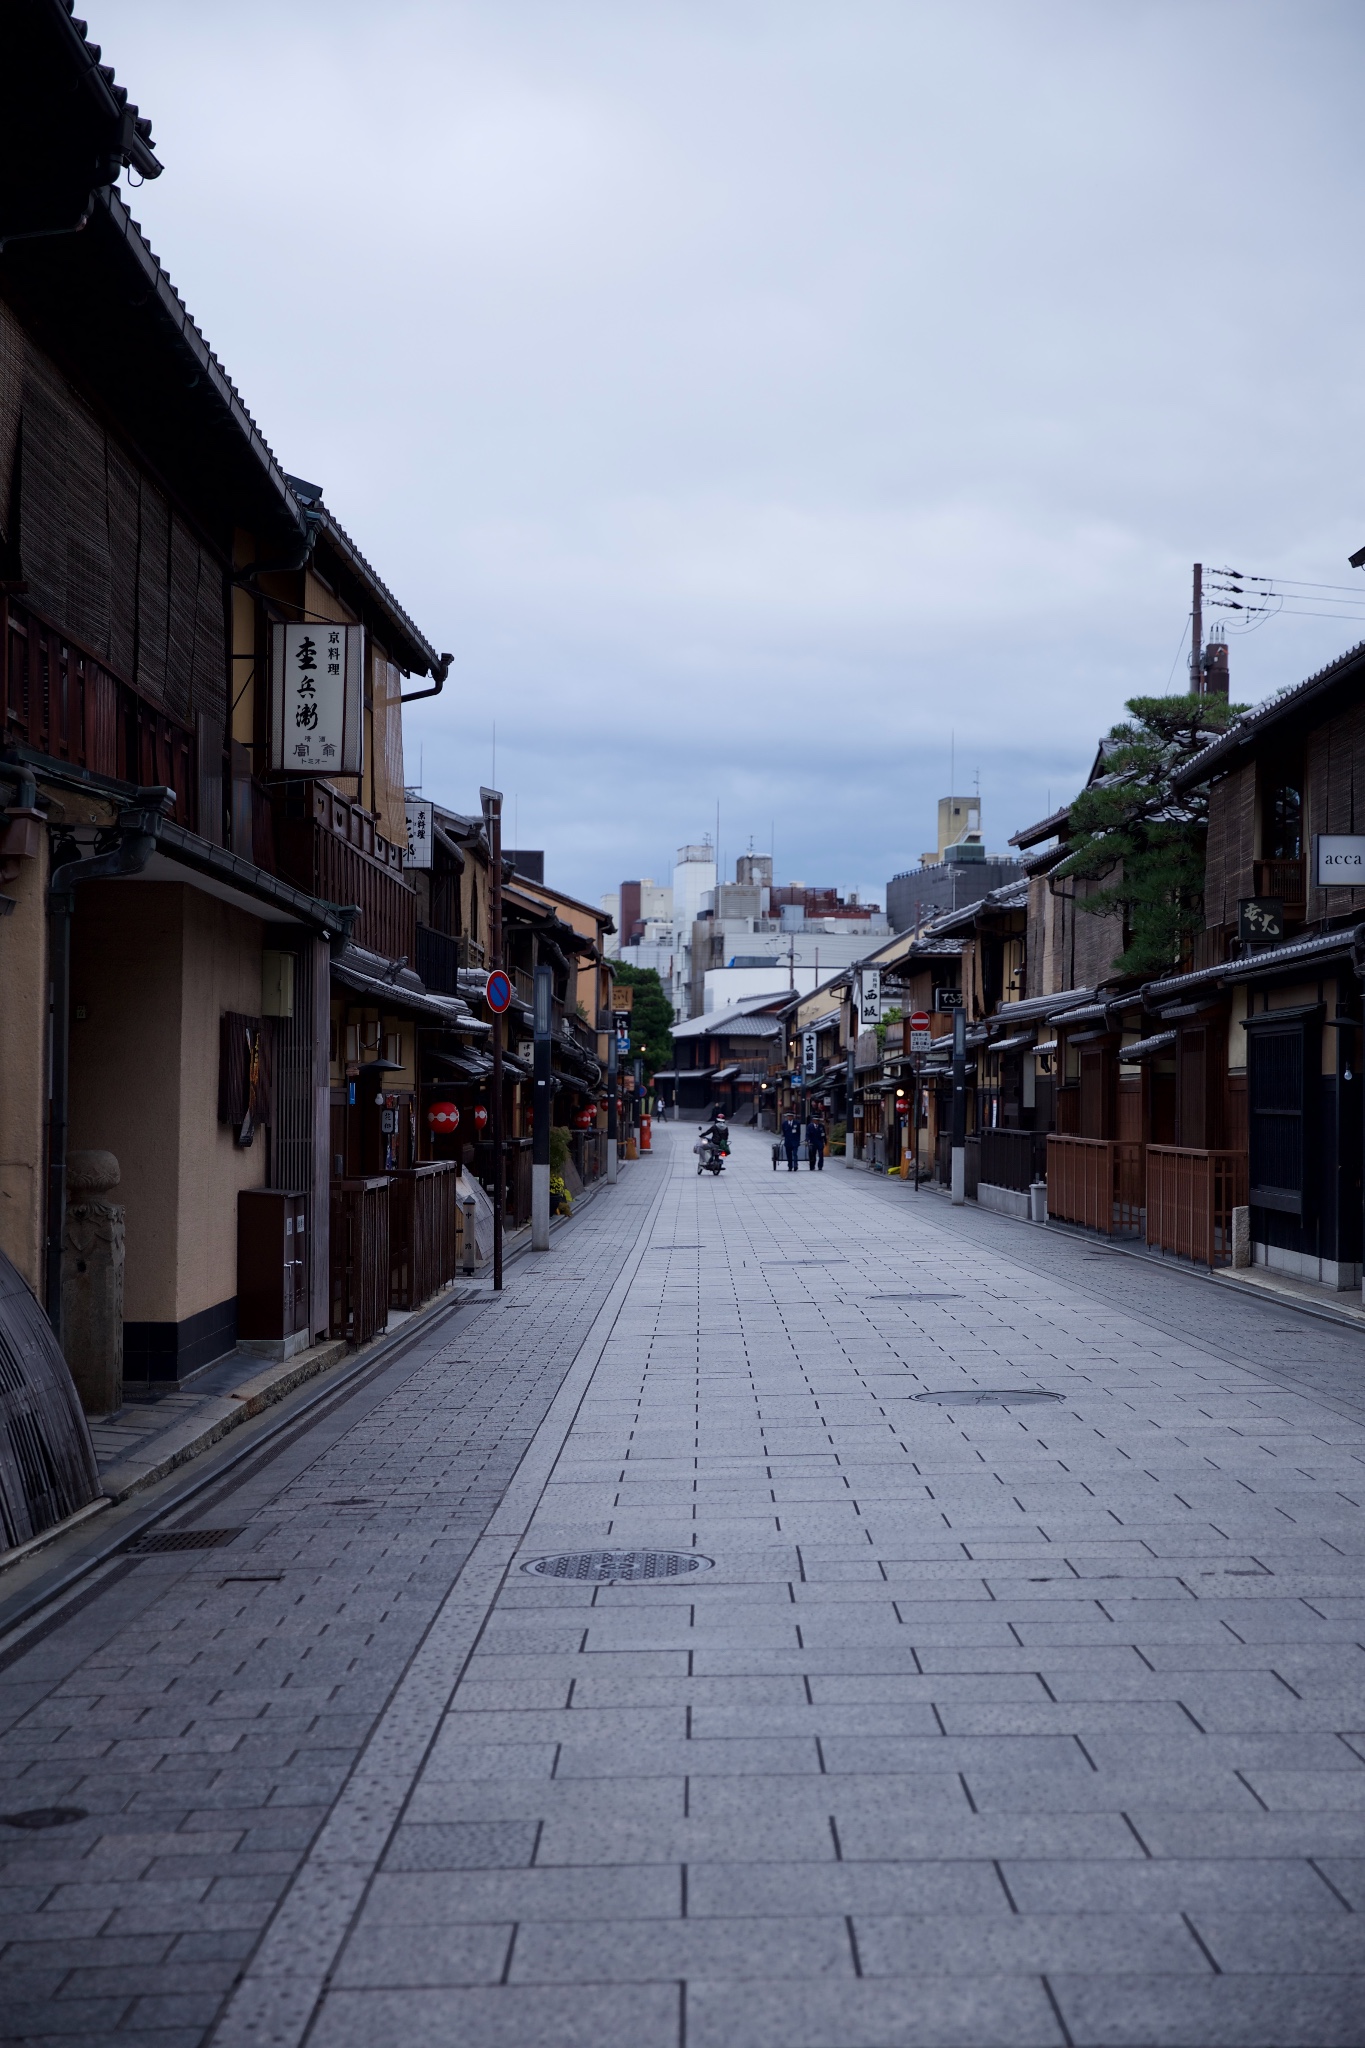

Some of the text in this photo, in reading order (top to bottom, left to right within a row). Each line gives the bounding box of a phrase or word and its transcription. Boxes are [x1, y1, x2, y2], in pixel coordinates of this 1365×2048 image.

[327, 631, 341, 676] 京料理
[1325, 854, 1362, 865] acca
